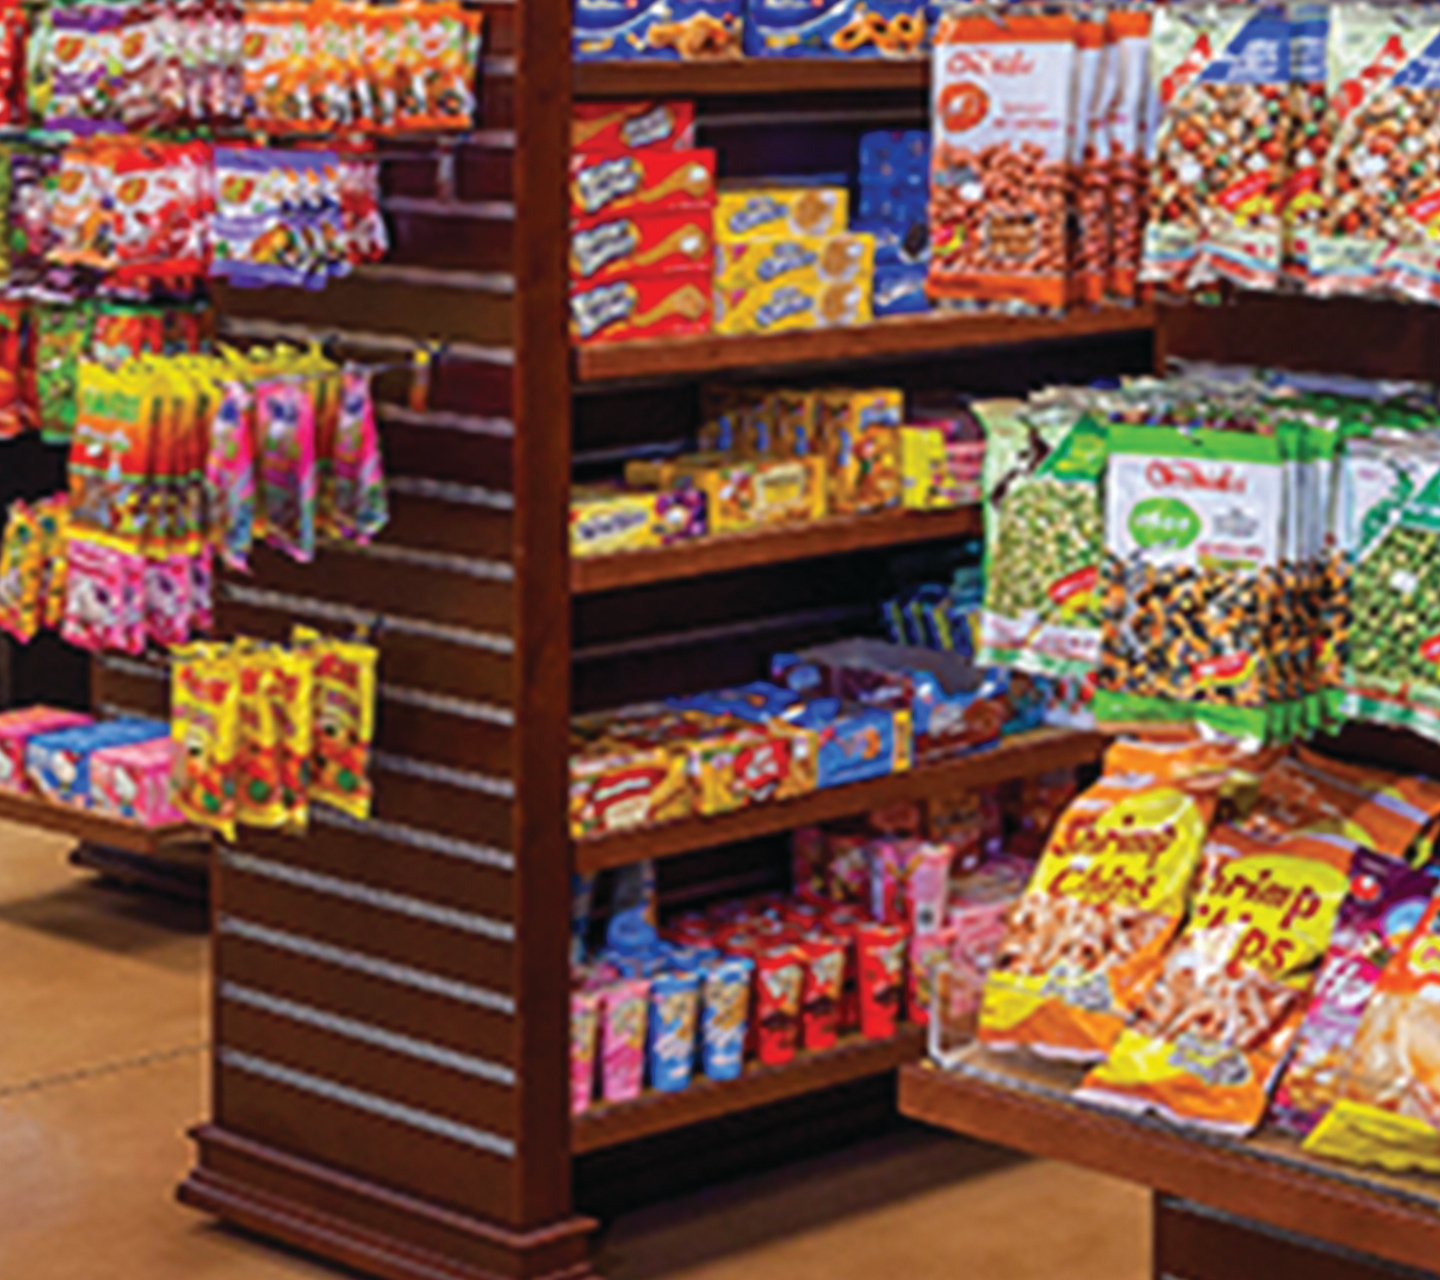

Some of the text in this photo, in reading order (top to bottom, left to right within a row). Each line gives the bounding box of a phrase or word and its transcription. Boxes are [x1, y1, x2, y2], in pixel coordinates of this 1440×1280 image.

[1051, 813, 1179, 869] Shrimp
[1046, 865, 1157, 904] Chips
[1206, 864, 1323, 930] hrimp
